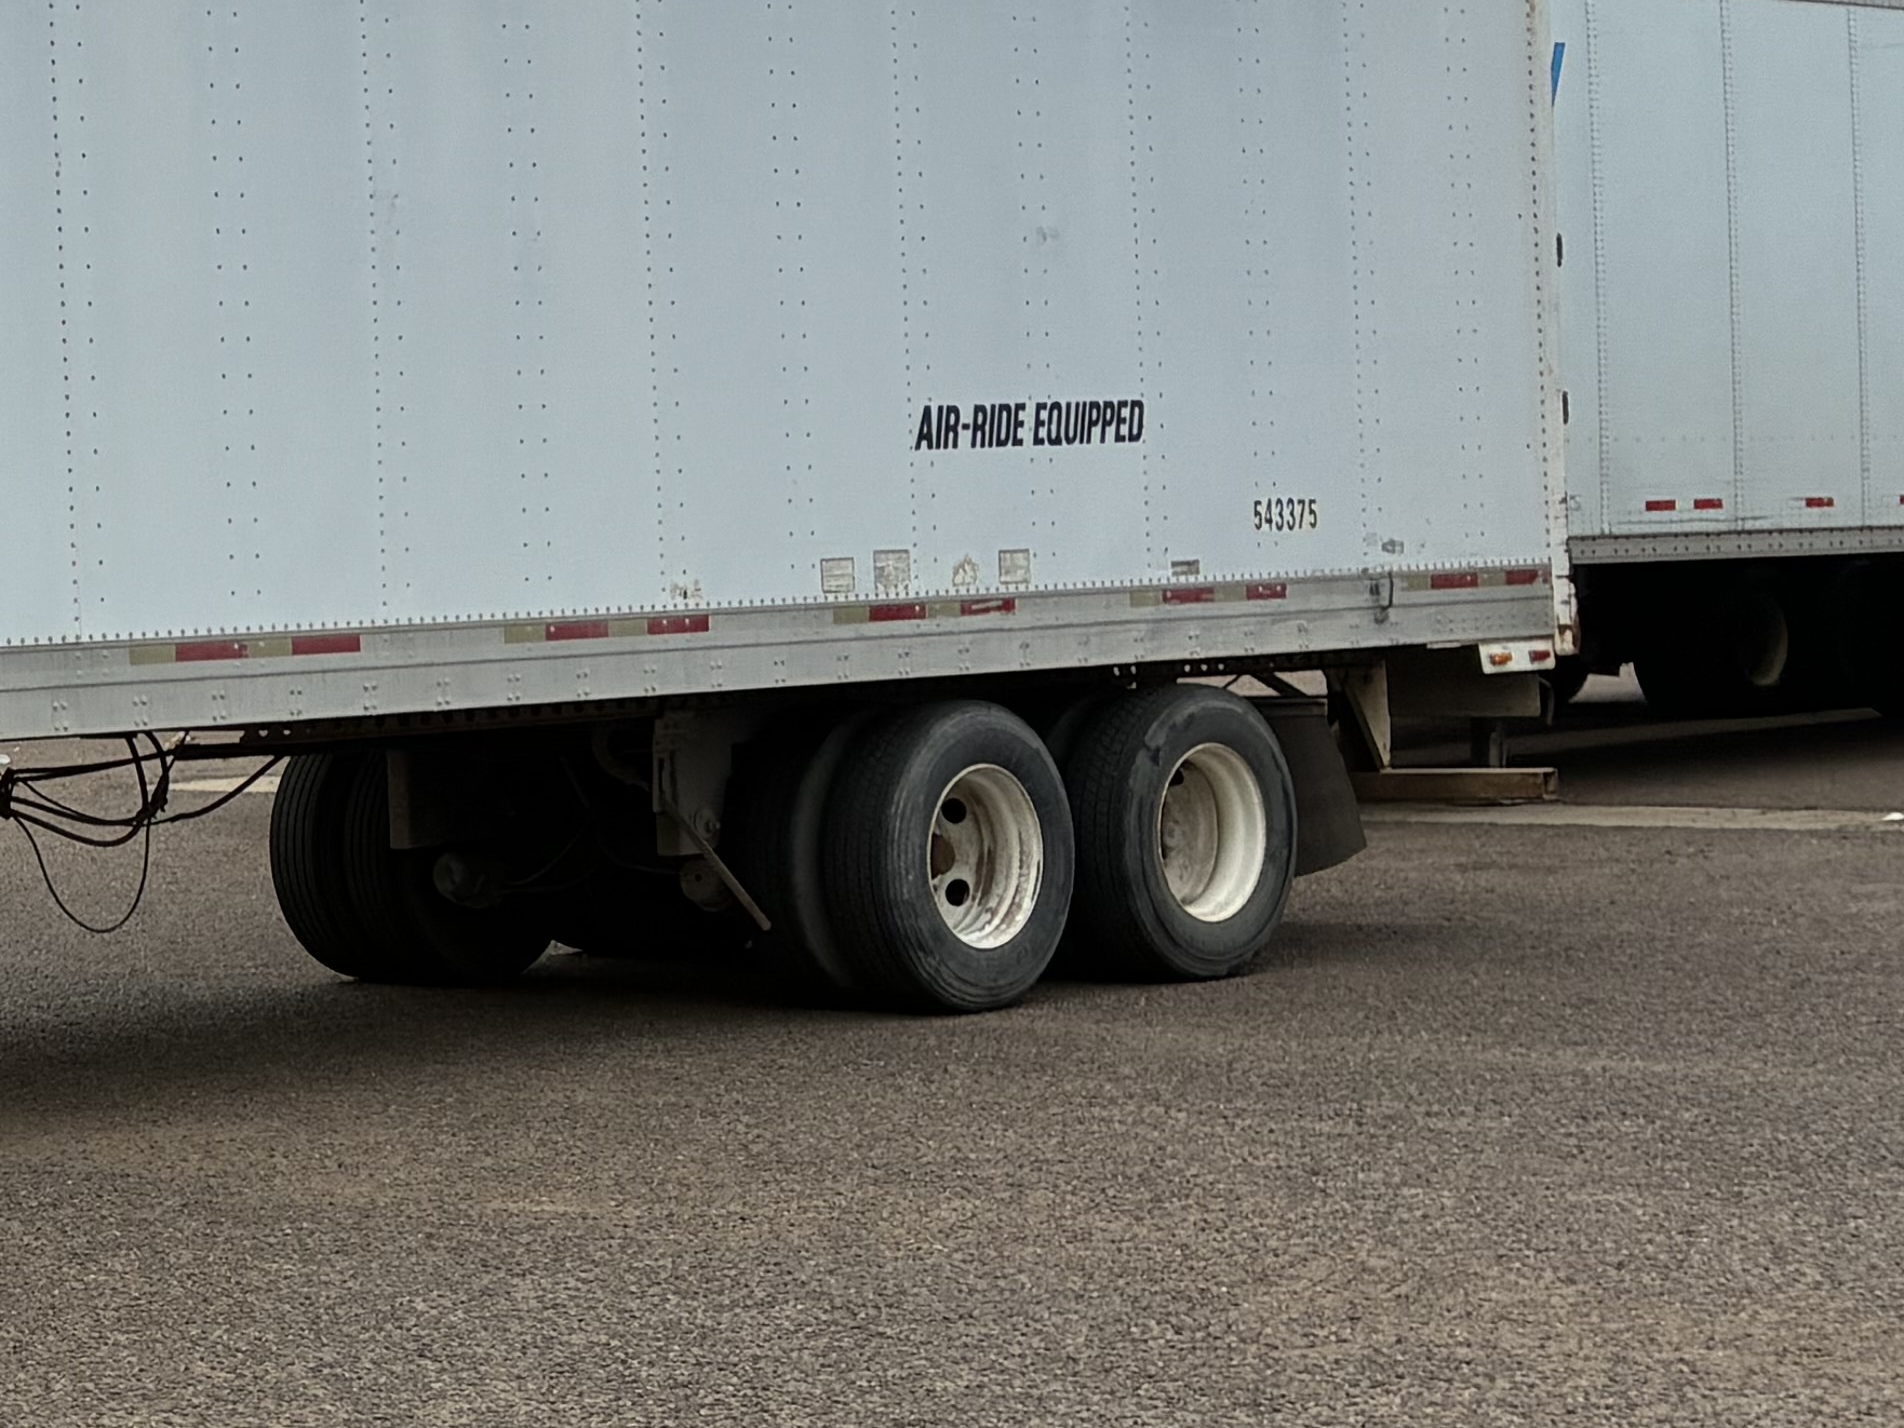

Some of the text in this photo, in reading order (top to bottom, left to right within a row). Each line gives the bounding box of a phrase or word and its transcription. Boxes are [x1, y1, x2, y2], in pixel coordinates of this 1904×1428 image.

[913, 399, 1145, 451] AIR-RIDE EQUIPPED
[1253, 496, 1318, 532] 543375
